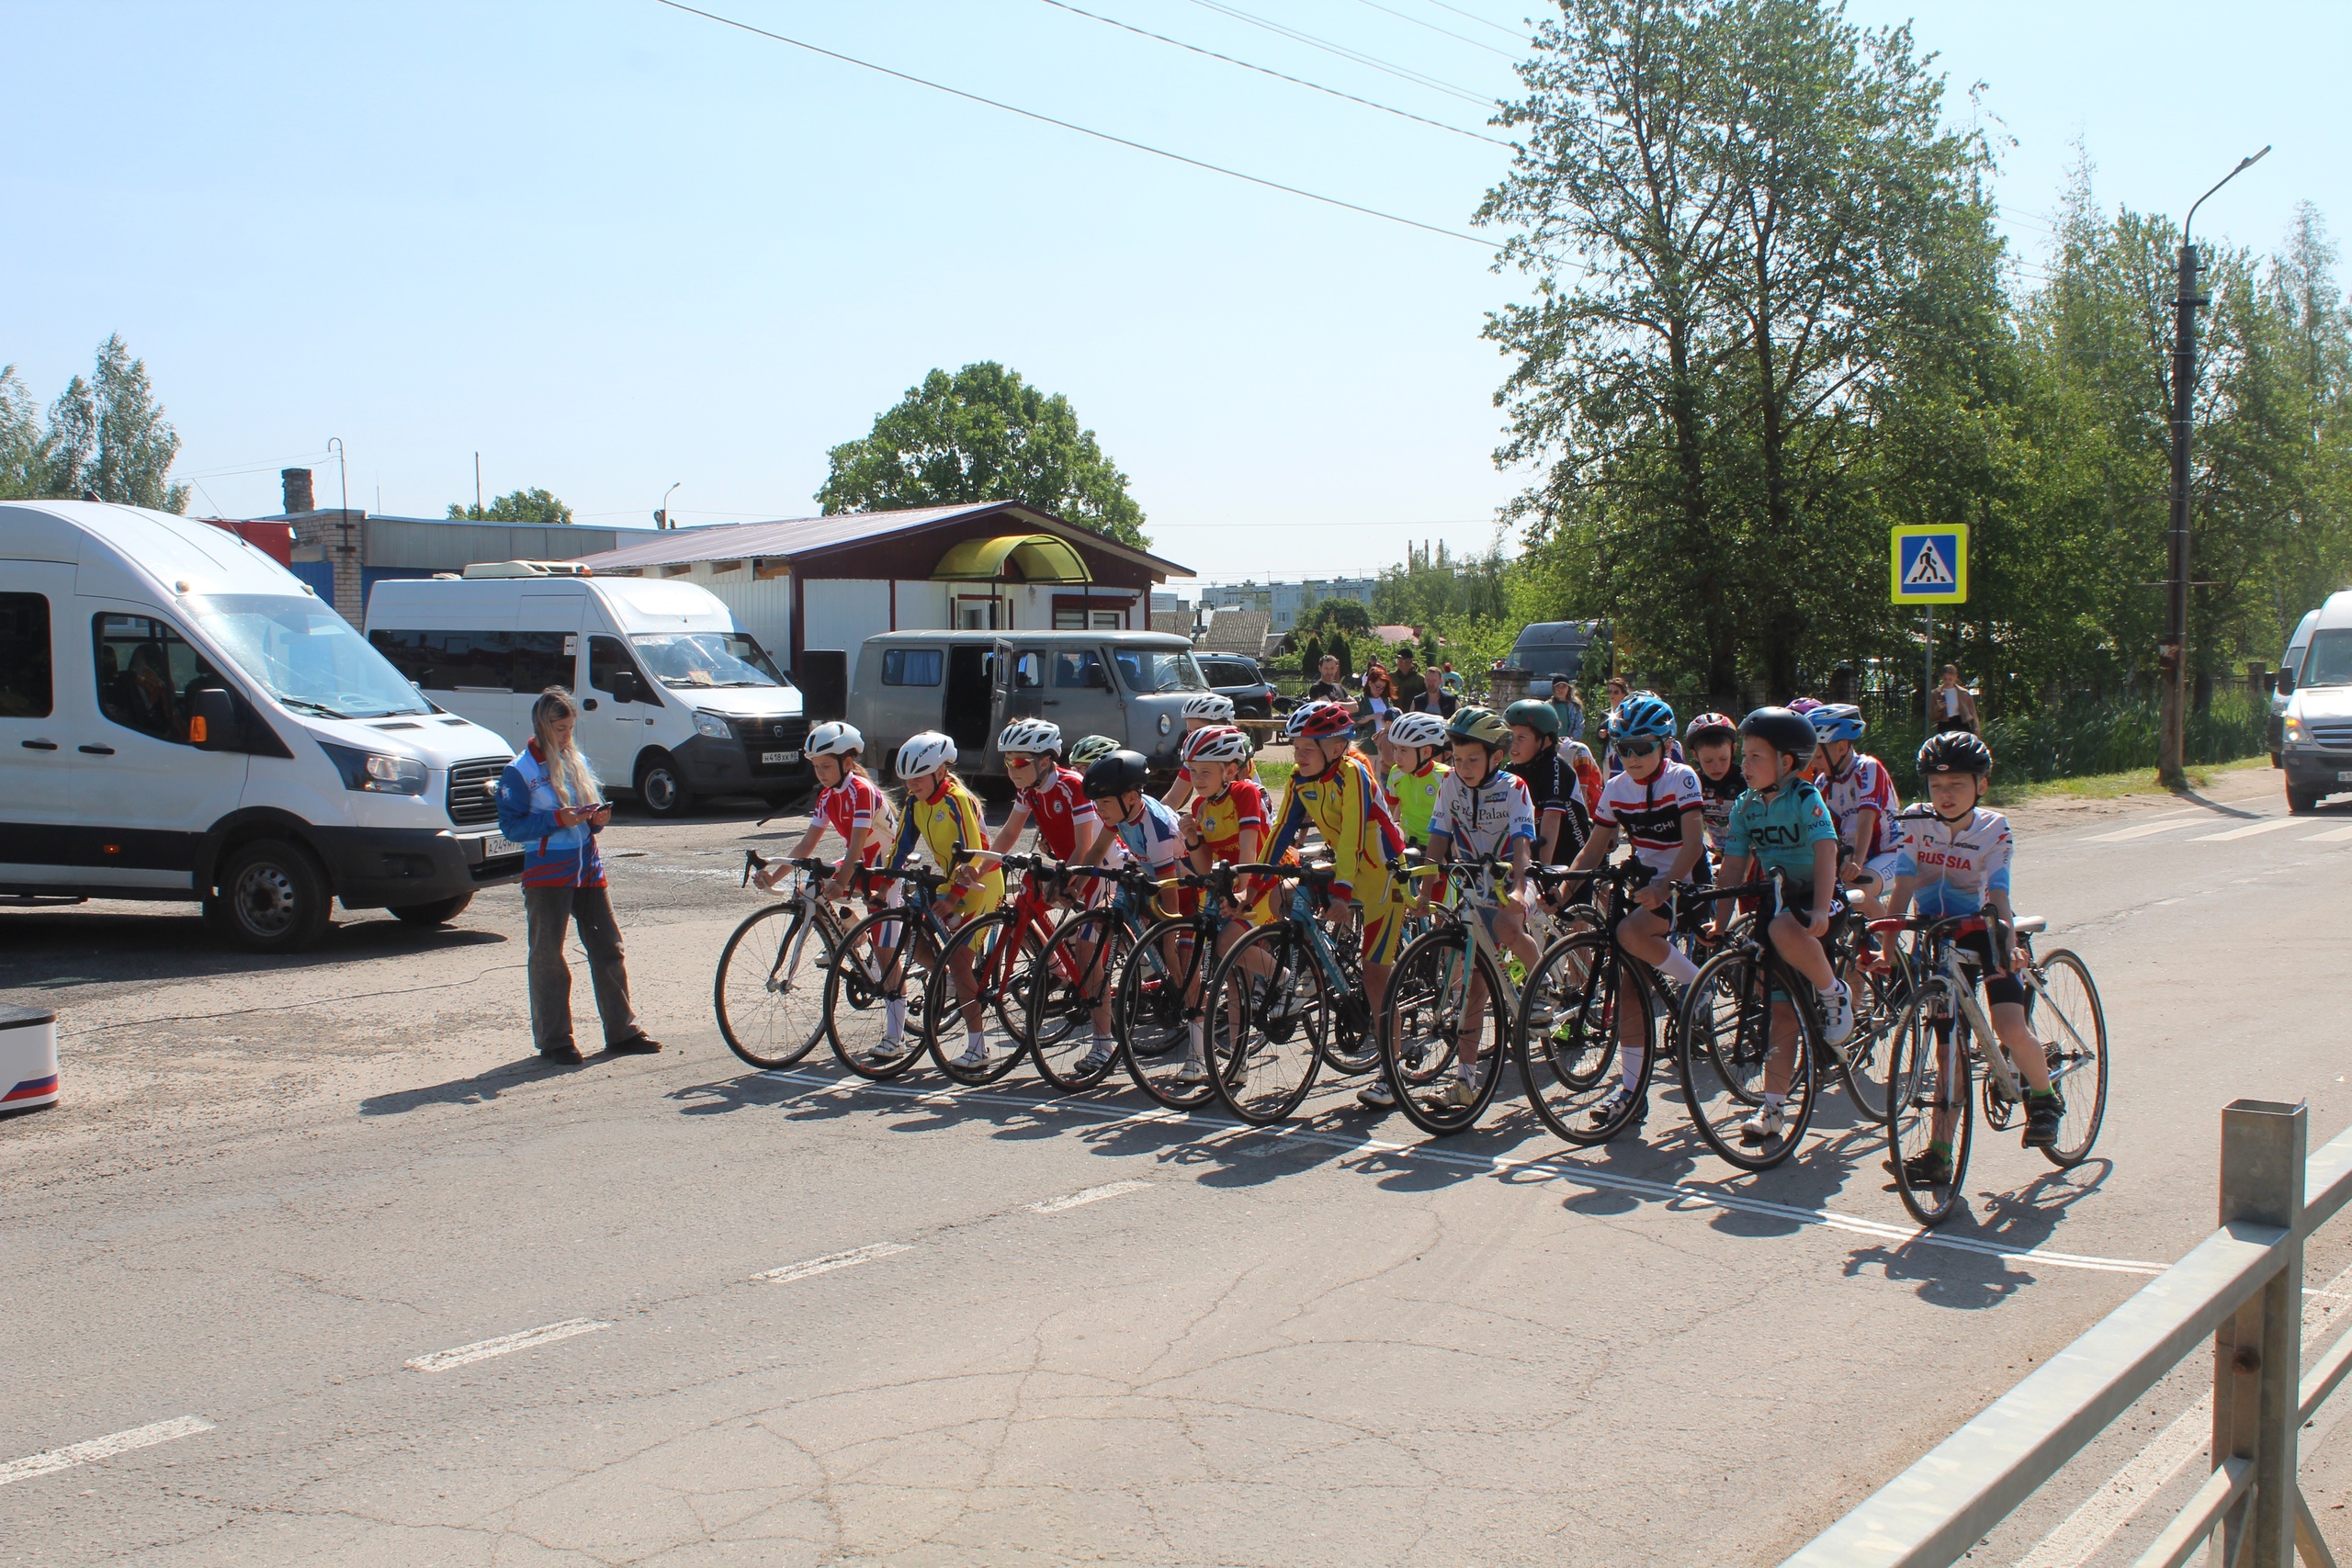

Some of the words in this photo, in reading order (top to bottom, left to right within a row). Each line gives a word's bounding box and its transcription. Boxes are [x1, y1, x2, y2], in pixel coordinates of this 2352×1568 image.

[1749, 823, 1800, 846] RCN
[1917, 851, 1972, 871] RUSSIA
[1105, 933, 1119, 974] LOKOSPHINX
[1203, 940, 1213, 982] LOKOSPHINX
[1287, 949, 1300, 992] LOKOSPHINX
